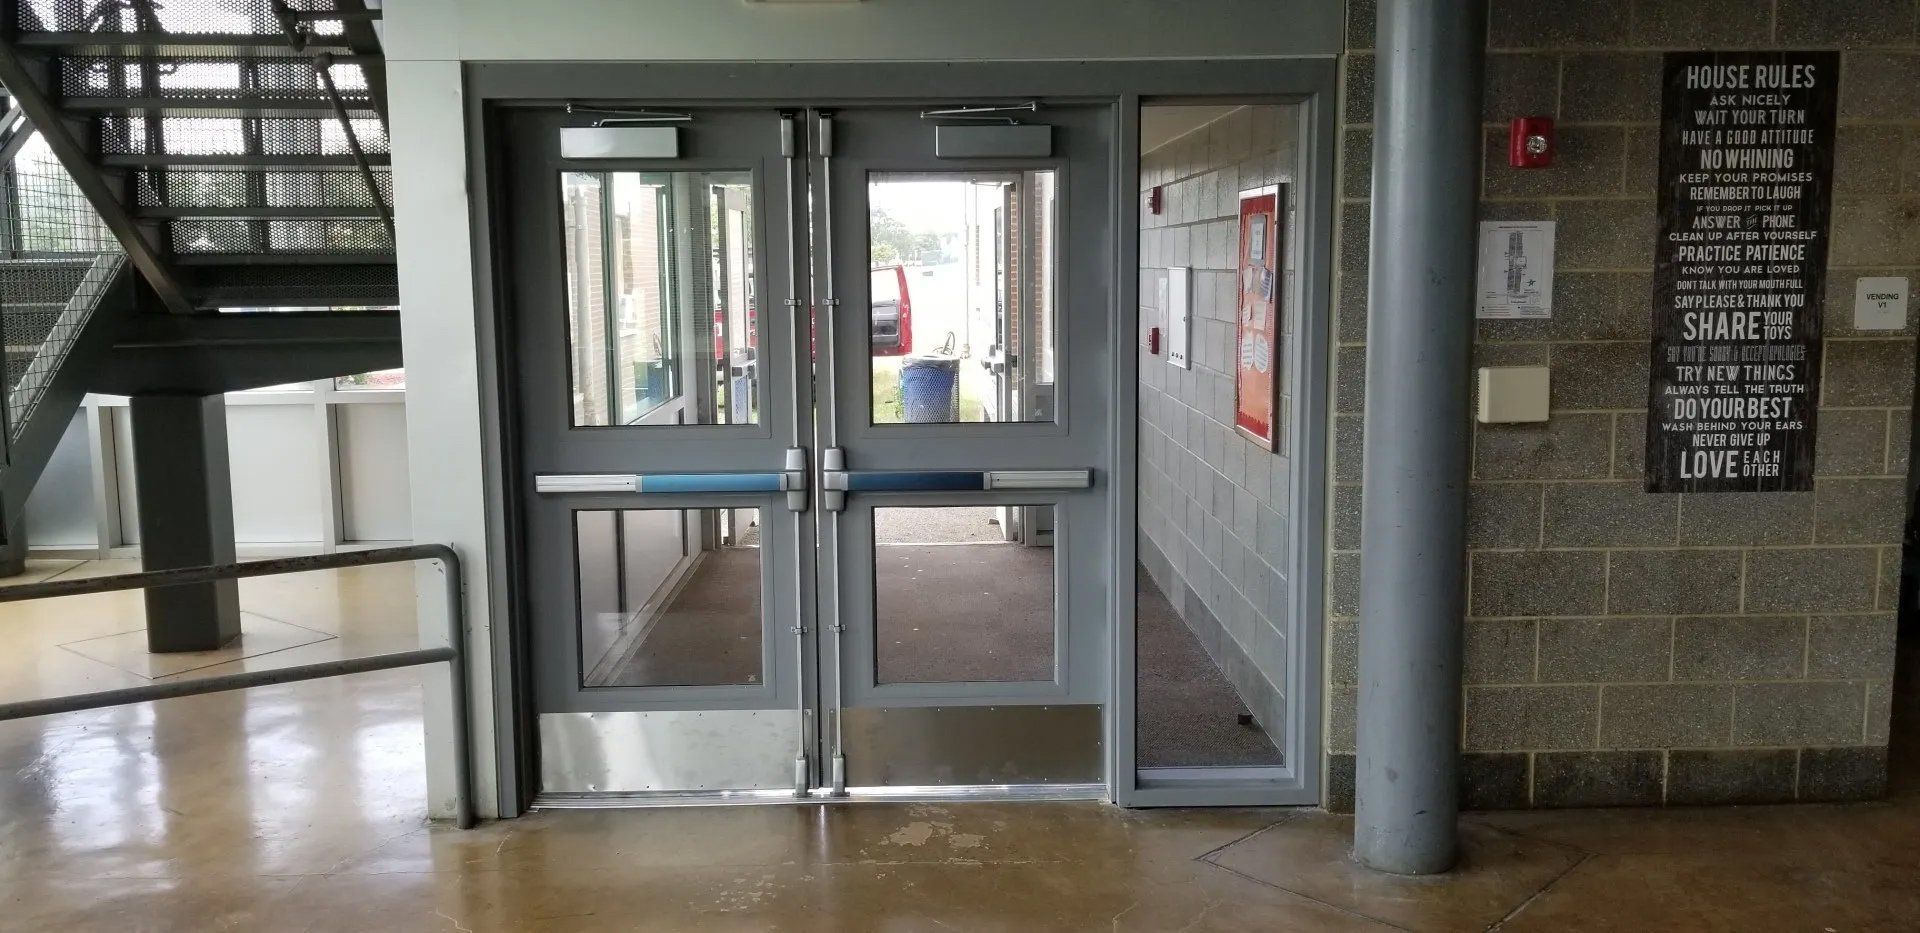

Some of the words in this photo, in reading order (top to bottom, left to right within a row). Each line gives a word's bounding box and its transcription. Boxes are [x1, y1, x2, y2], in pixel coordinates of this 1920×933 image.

[1687, 65, 1749, 89] HOUSE
[1756, 65, 1816, 88] RULES
[1710, 95, 1736, 106] ASK
[1742, 94, 1791, 105] NICELY
[1695, 110, 1727, 125] WAIT
[1733, 110, 1766, 124] YOUR
[1771, 110, 1805, 124] TURN
[1682, 131, 1710, 145] HAVE
[1716, 131, 1721, 145] A
[1727, 130, 1756, 144] GOOD
[1761, 129, 1814, 144] ATTITUDE
[1701, 149, 1722, 169] NO
[1726, 149, 1794, 168] WHINING
[1680, 174, 1709, 183] KEEP
[1715, 173, 1748, 182] YOUR
[1753, 173, 1812, 182] PROMISES
[1690, 187, 1749, 200] REMEMBER
[1752, 187, 1764, 199] TO
[1767, 186, 1800, 199] LAUGH
[1693, 216, 1740, 229] ANSWER
[1763, 215, 1795, 228] PHONE
[1669, 233, 1703, 241] CLEAN
[1708, 233, 1722, 241] UP
[1726, 232, 1759, 240] AFTER
[1763, 231, 1817, 240] YOURSELF
[1679, 246, 1741, 261] PRACTICE
[1746, 245, 1805, 260] PATIENCE
[1718, 266, 1740, 274] YOU
[1767, 265, 1799, 273] LOVED
[1699, 281, 1716, 289] TALK
[1719, 280, 1736, 289] WITH
[1739, 280, 1758, 289] YOUR
[1759, 280, 1785, 288] MOUTH
[1786, 280, 1803, 288] FULL
[1675, 296, 1695, 308] SAY
[1696, 295, 1736, 308] PLEASE
[1737, 295, 1745, 307] &
[1747, 295, 1781, 307] THANK
[1784, 294, 1804, 307] YOU
[1877, 301, 1887, 309] V1
[1683, 312, 1761, 340] SHARE
[1763, 312, 1793, 325] YOUR
[1763, 326, 1792, 340] TOYS
[1676, 366, 1703, 381] TRY
[1707, 366, 1740, 381] NEW
[1744, 365, 1795, 380] THINGS
[1665, 386, 1709, 395] ALWAYS
[1714, 386, 1739, 394] TELL
[1744, 385, 1764, 393] THE
[1770, 385, 1804, 393] TRUTH
[1674, 399, 1696, 419] DO
[1701, 398, 1744, 419] YOUR
[1748, 397, 1792, 418] BEST
[1662, 423, 1693, 431] WASH
[1697, 422, 1736, 430] BEHIND
[1741, 422, 1771, 430] YOUR
[1693, 434, 1726, 447] NEVER
[1730, 434, 1754, 446] GIVE
[1757, 433, 1770, 446] UP
[1680, 451, 1738, 478] LOVE
[1744, 450, 1780, 463] EACH
[1743, 464, 1779, 476] OTHER
